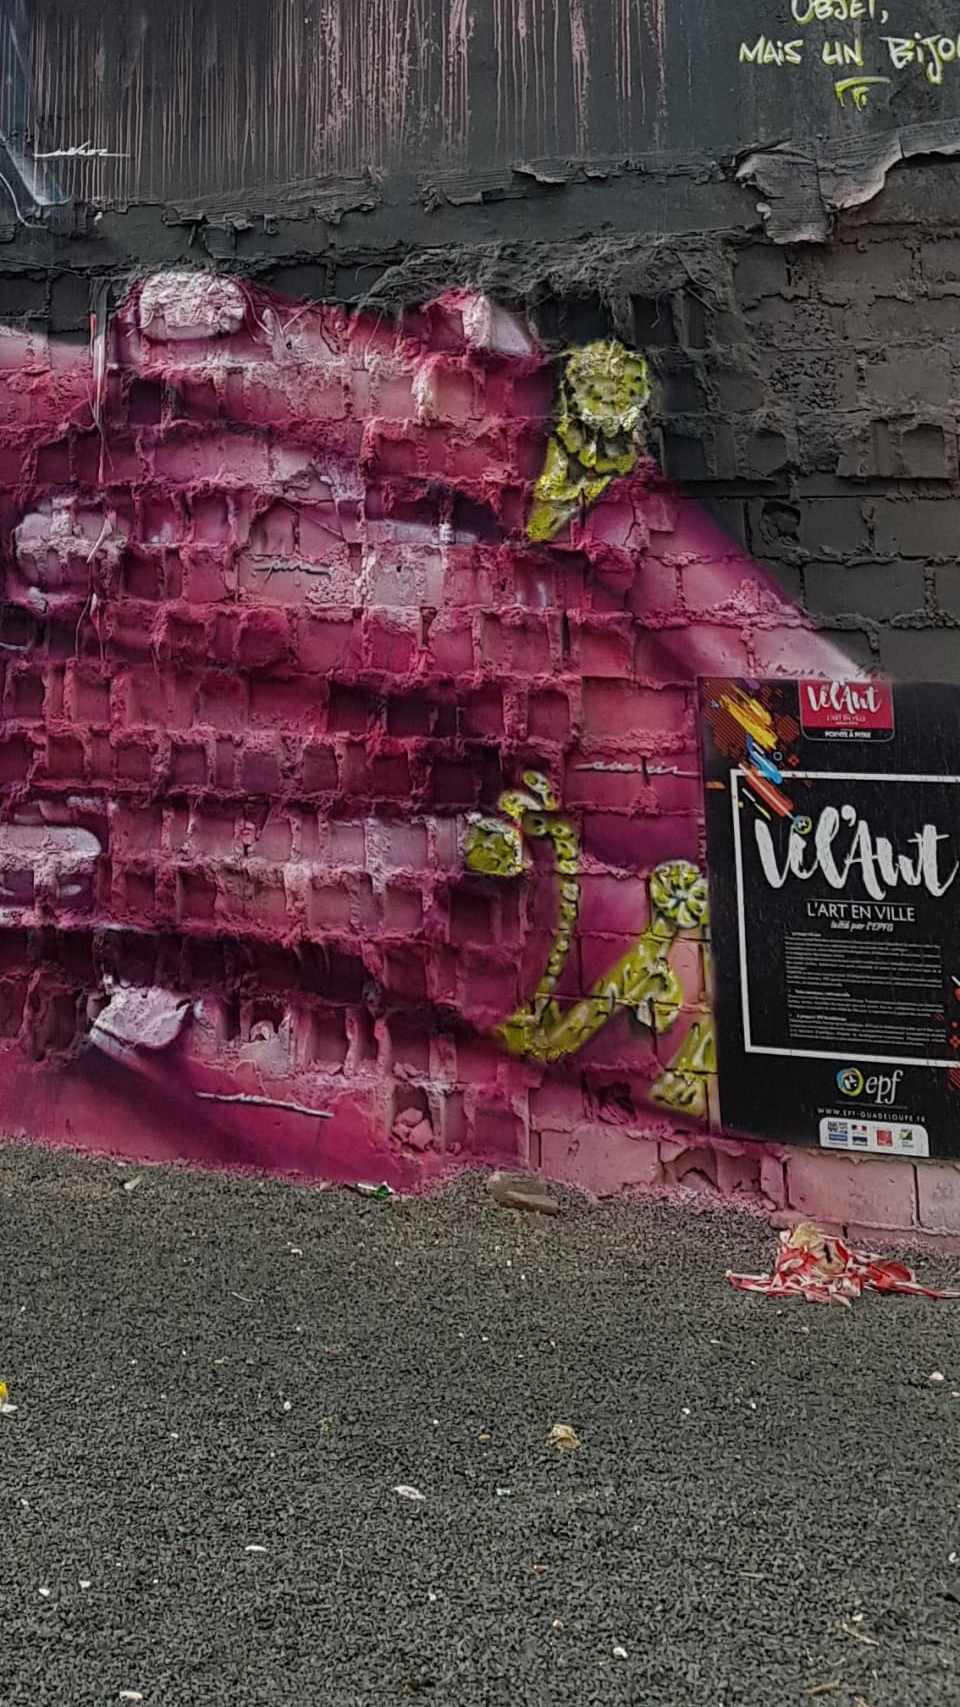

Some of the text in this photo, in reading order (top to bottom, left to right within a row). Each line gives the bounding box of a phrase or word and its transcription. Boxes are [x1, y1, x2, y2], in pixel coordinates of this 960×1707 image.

[822, 40, 864, 67] UN
[807, 902, 916, 922] L'ART EN VILLE
[865, 1069, 904, 1105] epf
